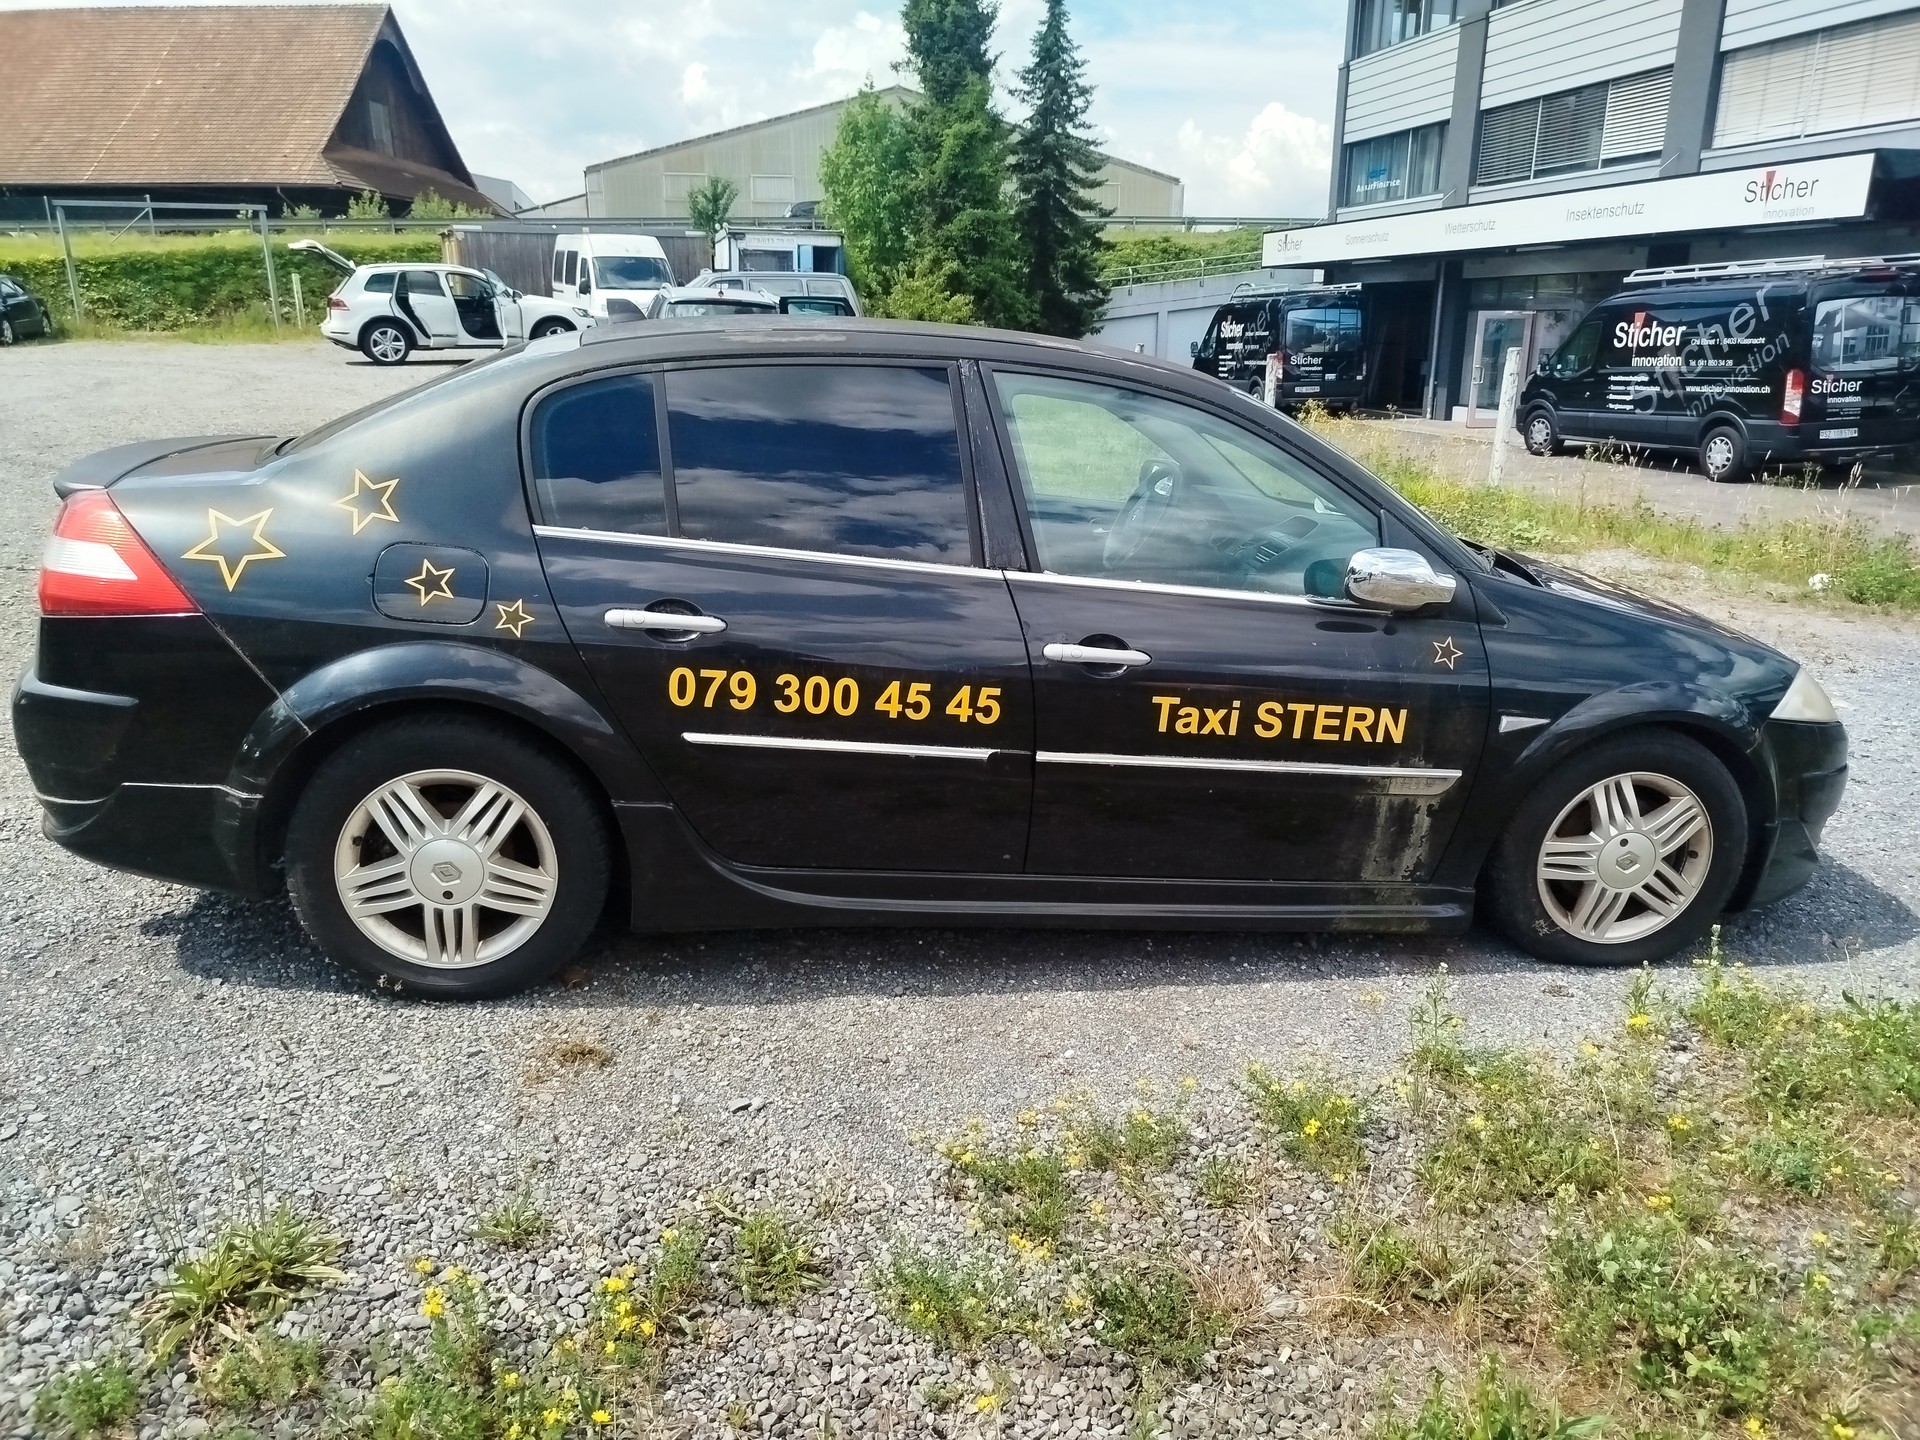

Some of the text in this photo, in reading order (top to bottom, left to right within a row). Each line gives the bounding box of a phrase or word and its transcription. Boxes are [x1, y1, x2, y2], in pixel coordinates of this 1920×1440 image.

[1744, 172, 1819, 204] Sticher
[1566, 202, 1645, 222] Insektenschutz
[1762, 204, 1815, 219] innovation
[1444, 219, 1497, 235] Wetterschutz
[1345, 231, 1390, 245] Sonnenschutz
[1613, 316, 1687, 348] Sticher
[1290, 354, 1323, 365] Sticher
[1631, 354, 1682, 368] innovation
[1811, 377, 1862, 394] Sticher
[1826, 395, 1862, 403] innovation
[668, 667, 1002, 725] 079 300 45 45
[1152, 696, 1408, 744] Taxi STERN
